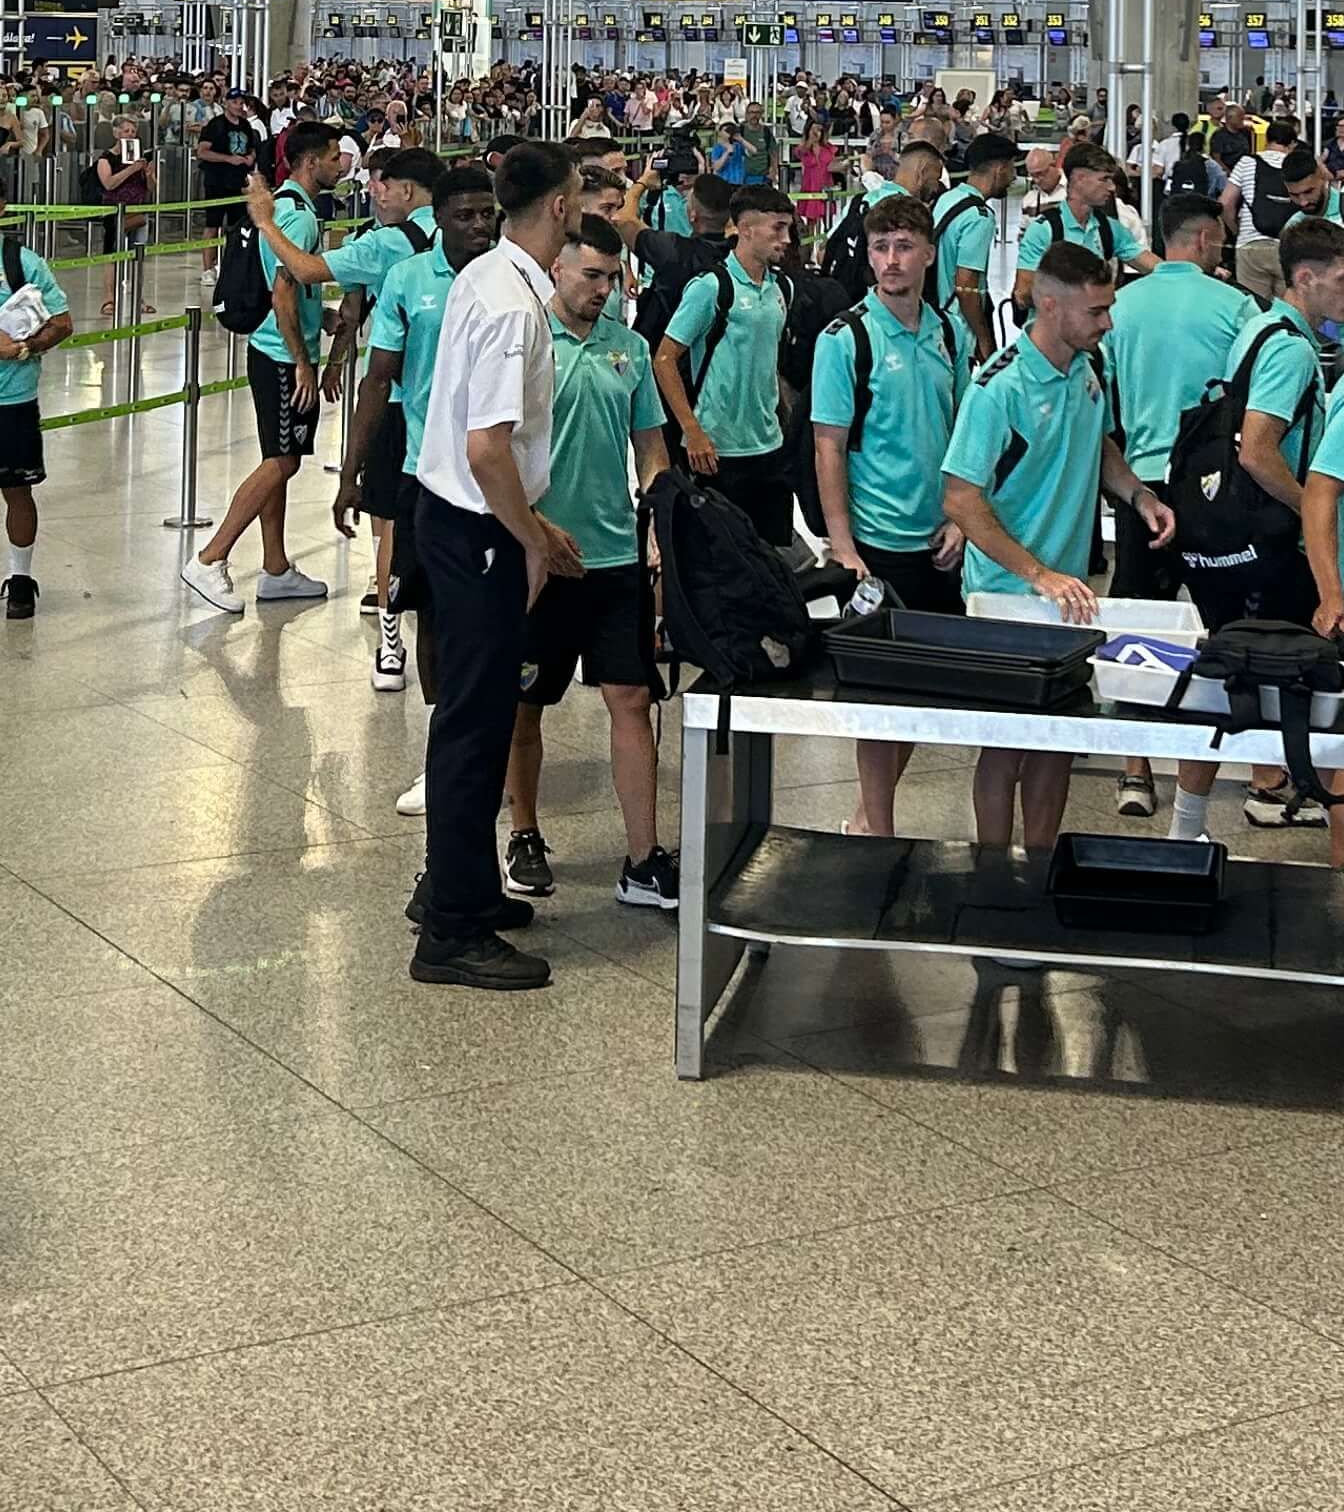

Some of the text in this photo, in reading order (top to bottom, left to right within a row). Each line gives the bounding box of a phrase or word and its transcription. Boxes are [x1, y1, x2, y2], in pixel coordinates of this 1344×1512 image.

[1199, 14, 1211, 26] 56
[1247, 14, 1264, 27] 357
[1197, 543, 1259, 569] hummel
